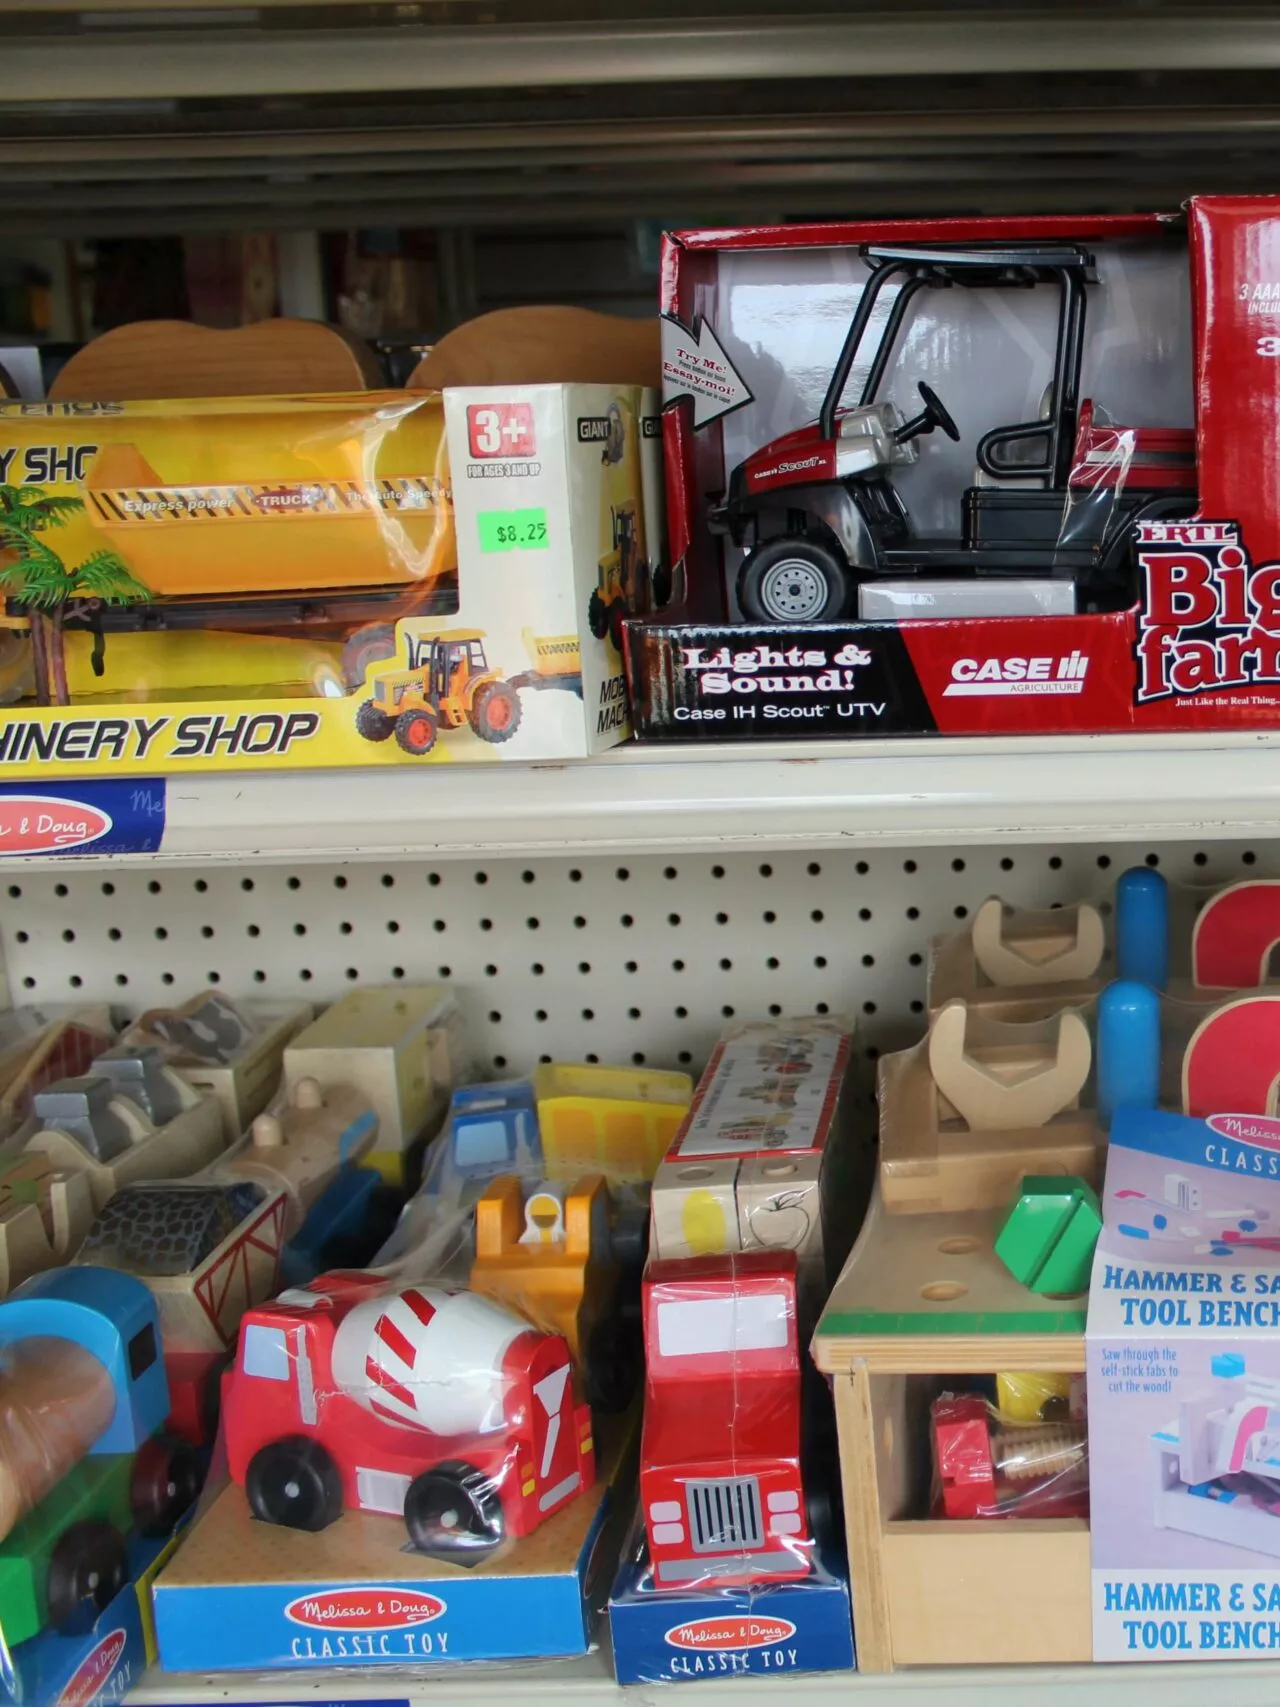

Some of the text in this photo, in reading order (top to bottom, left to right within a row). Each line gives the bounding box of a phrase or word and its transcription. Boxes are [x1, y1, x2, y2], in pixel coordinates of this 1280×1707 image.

[1239, 282, 1280, 299] 3 AAA
[676, 348, 727, 373] Try Me!
[663, 362, 735, 396] Essay-moi!
[475, 410, 526, 454] 3+
[579, 420, 609, 439] GIANT
[468, 463, 541, 479] FOR AGES 3 AND UP
[124, 497, 235, 514] Express power
[496, 523, 547, 543] $8.25
[1140, 524, 1237, 545] ERTL
[683, 644, 872, 673] Lights &
[951, 658, 1053, 681] CASE
[700, 670, 855, 694] Sound!
[1010, 683, 1079, 693] AGRICULTURE
[673, 702, 886, 720] Case IH UTV
[1175, 697, 1193, 707] Just
[1195, 697, 1214, 706] Like
[1215, 697, 1229, 705] the
[1231, 696, 1248, 705] Real
[169, 712, 320, 756] SHOP
[37, 814, 88, 843] Doug
[1103, 1264, 1223, 1293] HAMMER
[1230, 1274, 1247, 1294] &
[1120, 1298, 1192, 1326] TOOL
[1102, 1347, 1177, 1365] Saw through the
[1101, 1364, 1179, 1377] self-stick tabs to
[1108, 1380, 1172, 1393] cut the wood!
[1103, 1582, 1221, 1611] HAMMER
[1229, 1583, 1245, 1611] &
[302, 1599, 431, 1622] Melissa & Doug
[291, 1631, 449, 1659] CLASSIC TOY
[678, 1624, 783, 1644] Melissa & Doug
[1122, 1621, 1192, 1649] TOOL
[670, 1649, 797, 1674] CLASSIC TOY
[110, 1661, 131, 1699] TOY
